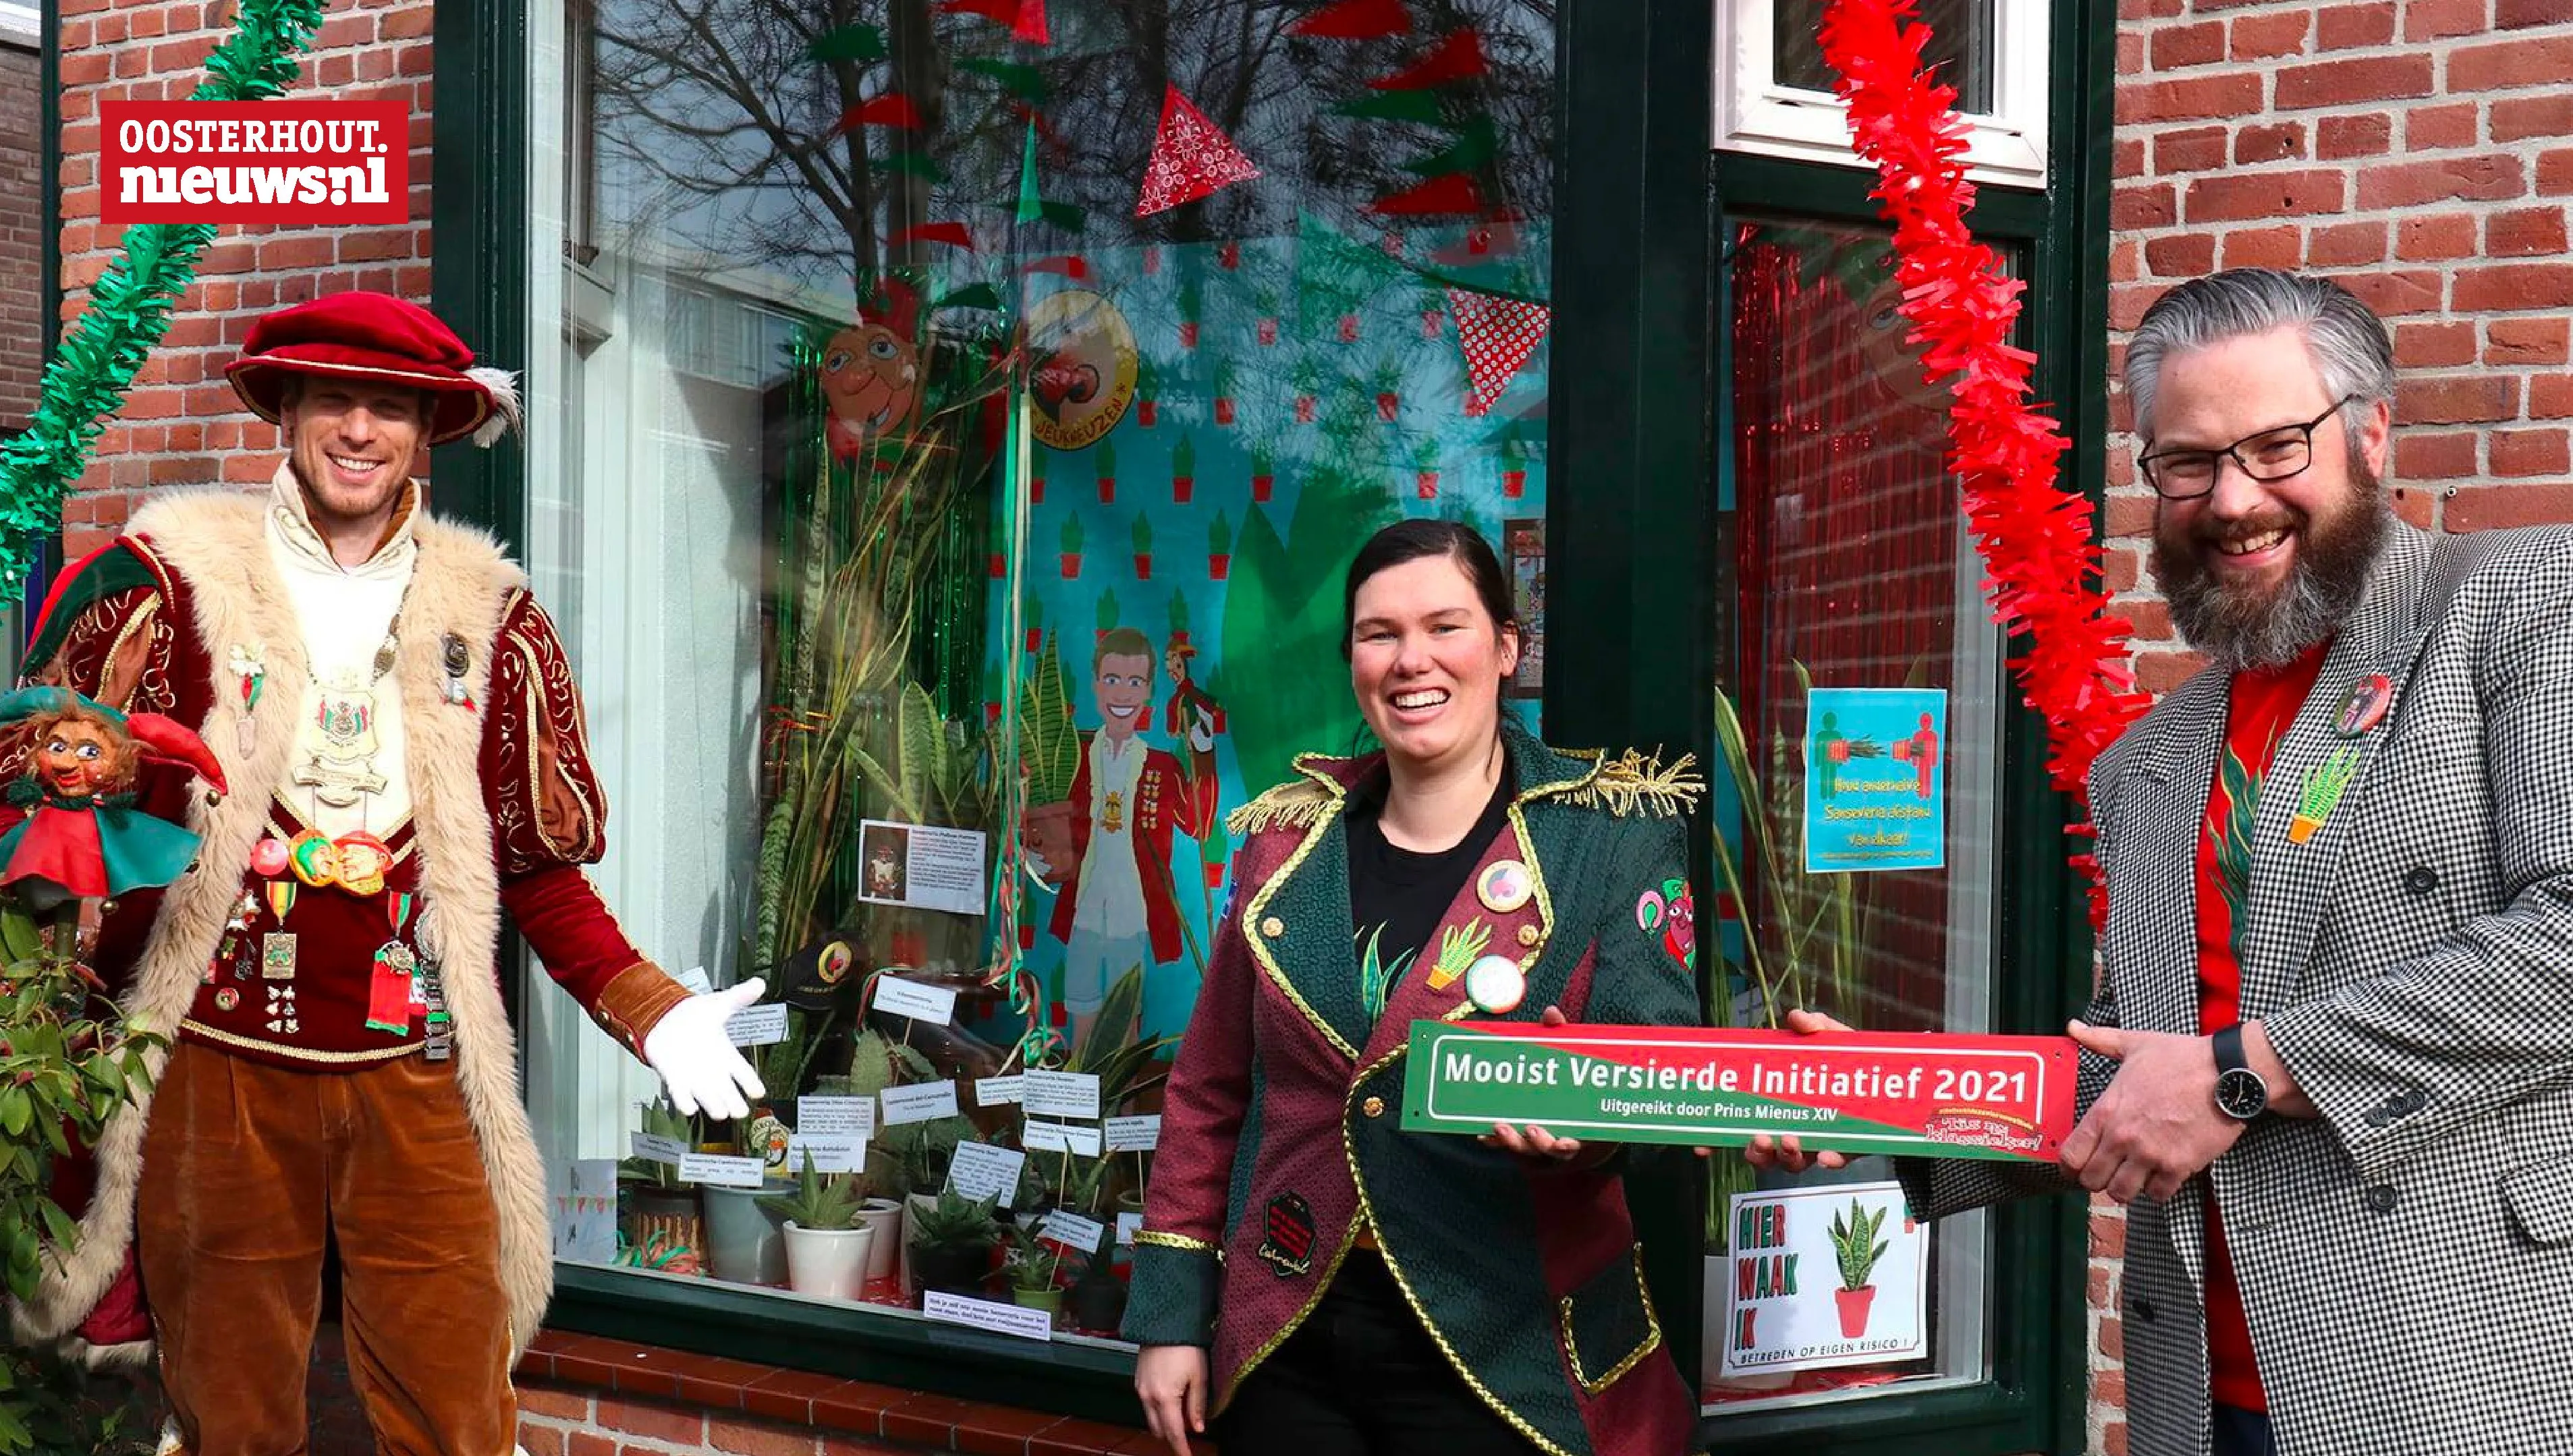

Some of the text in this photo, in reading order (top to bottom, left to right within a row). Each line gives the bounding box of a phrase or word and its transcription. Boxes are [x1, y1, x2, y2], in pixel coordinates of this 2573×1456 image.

[1445, 1053, 2025, 1102] Mooist Versierde Initiatief 2021
[1601, 1098, 1839, 1121] Uitgereikt door Prins Mienus XIV
[1739, 1204, 1787, 1250] HIER
[1738, 1254, 1799, 1301] WAAK
[1734, 1308, 1758, 1351] IK
[1740, 1349, 1795, 1364] BETREDEN
[1800, 1347, 1816, 1357] OP
[1820, 1343, 1854, 1355] EIGEN
[1860, 1339, 1900, 1351] RISICO
